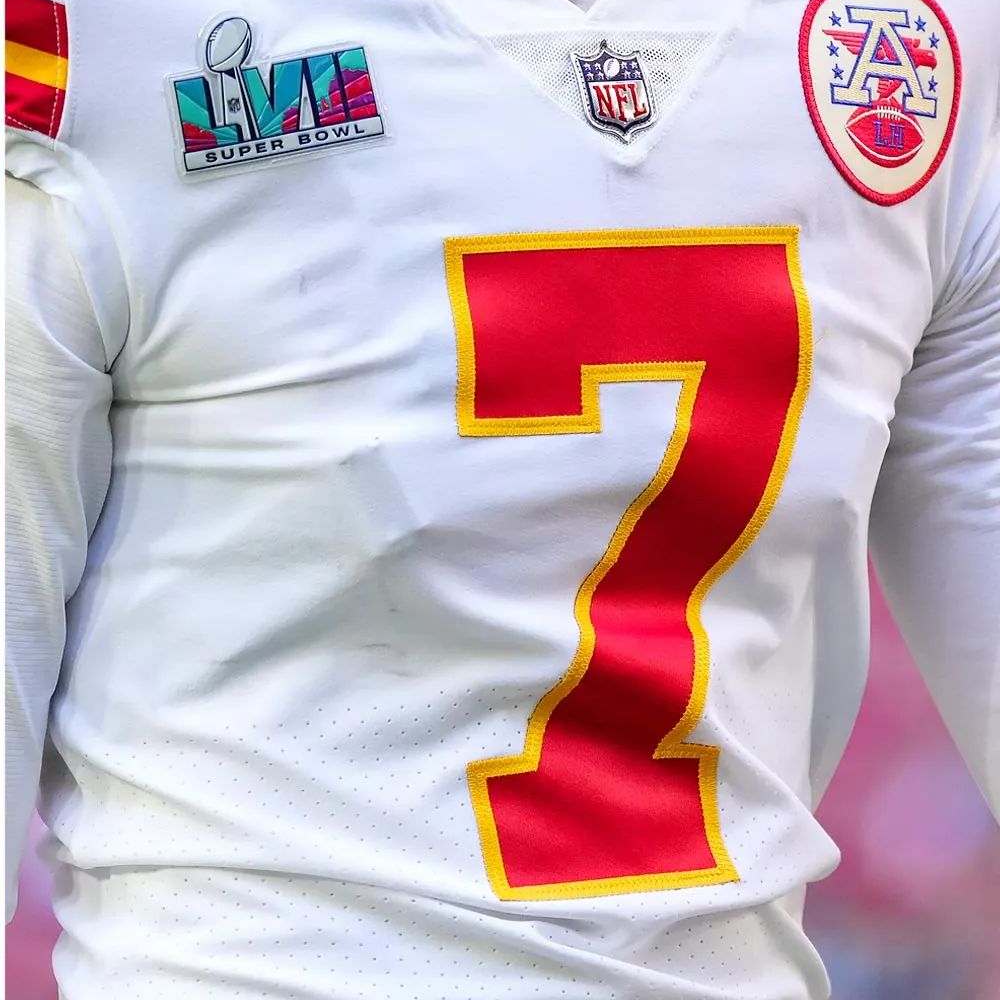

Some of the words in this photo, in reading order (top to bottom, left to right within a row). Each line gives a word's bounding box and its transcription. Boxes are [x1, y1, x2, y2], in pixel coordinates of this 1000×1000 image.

[829, 5, 938, 118] A
[174, 47, 379, 152] LVII
[593, 83, 648, 123] NFL
[872, 120, 905, 149] LH
[205, 139, 285, 163] SUPER
[298, 124, 366, 146] BOWL
[443, 225, 812, 902] 7
